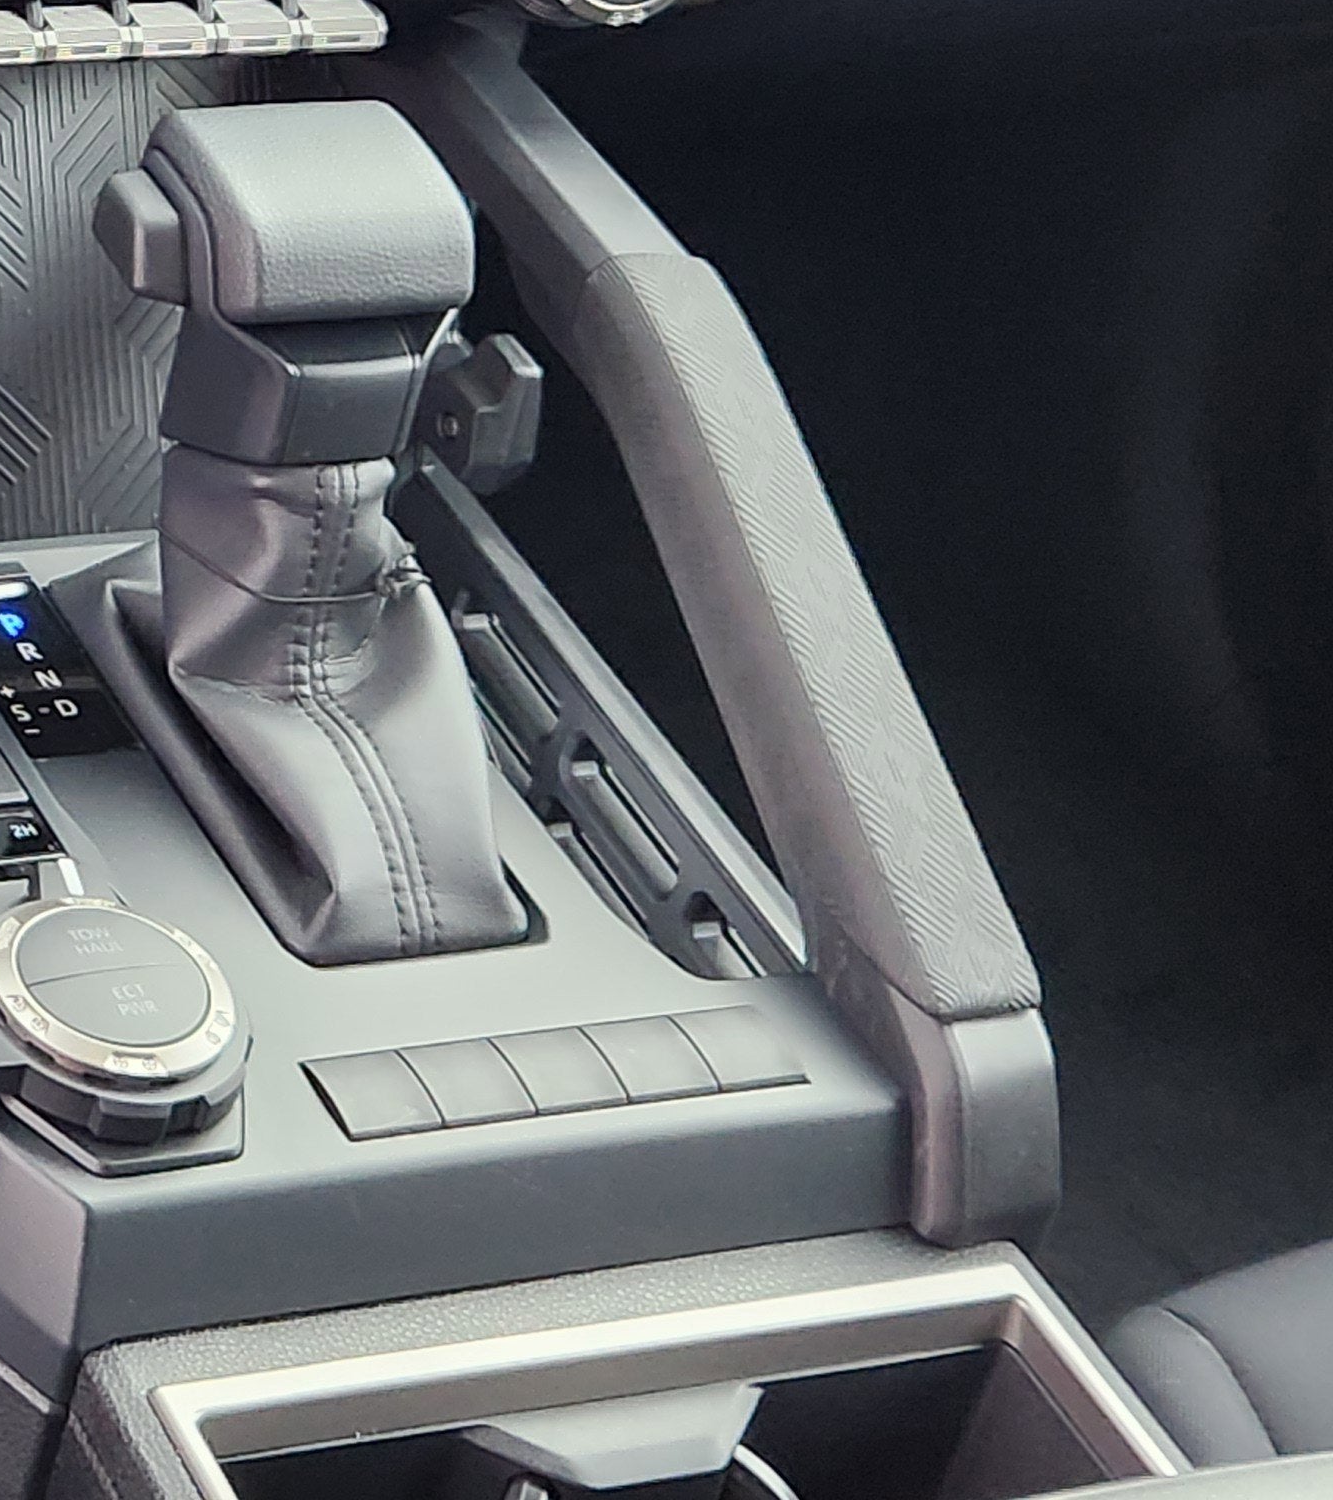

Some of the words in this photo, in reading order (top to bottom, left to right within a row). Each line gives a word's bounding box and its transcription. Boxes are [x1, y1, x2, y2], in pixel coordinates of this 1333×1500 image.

[16, 641, 44, 663] R
[34, 668, 63, 690] N
[9, 703, 33, 723] S
[53, 698, 79, 718] D
[9, 822, 39, 840] 2H
[111, 983, 147, 1001] ECT
[116, 1000, 160, 1017] PWR
